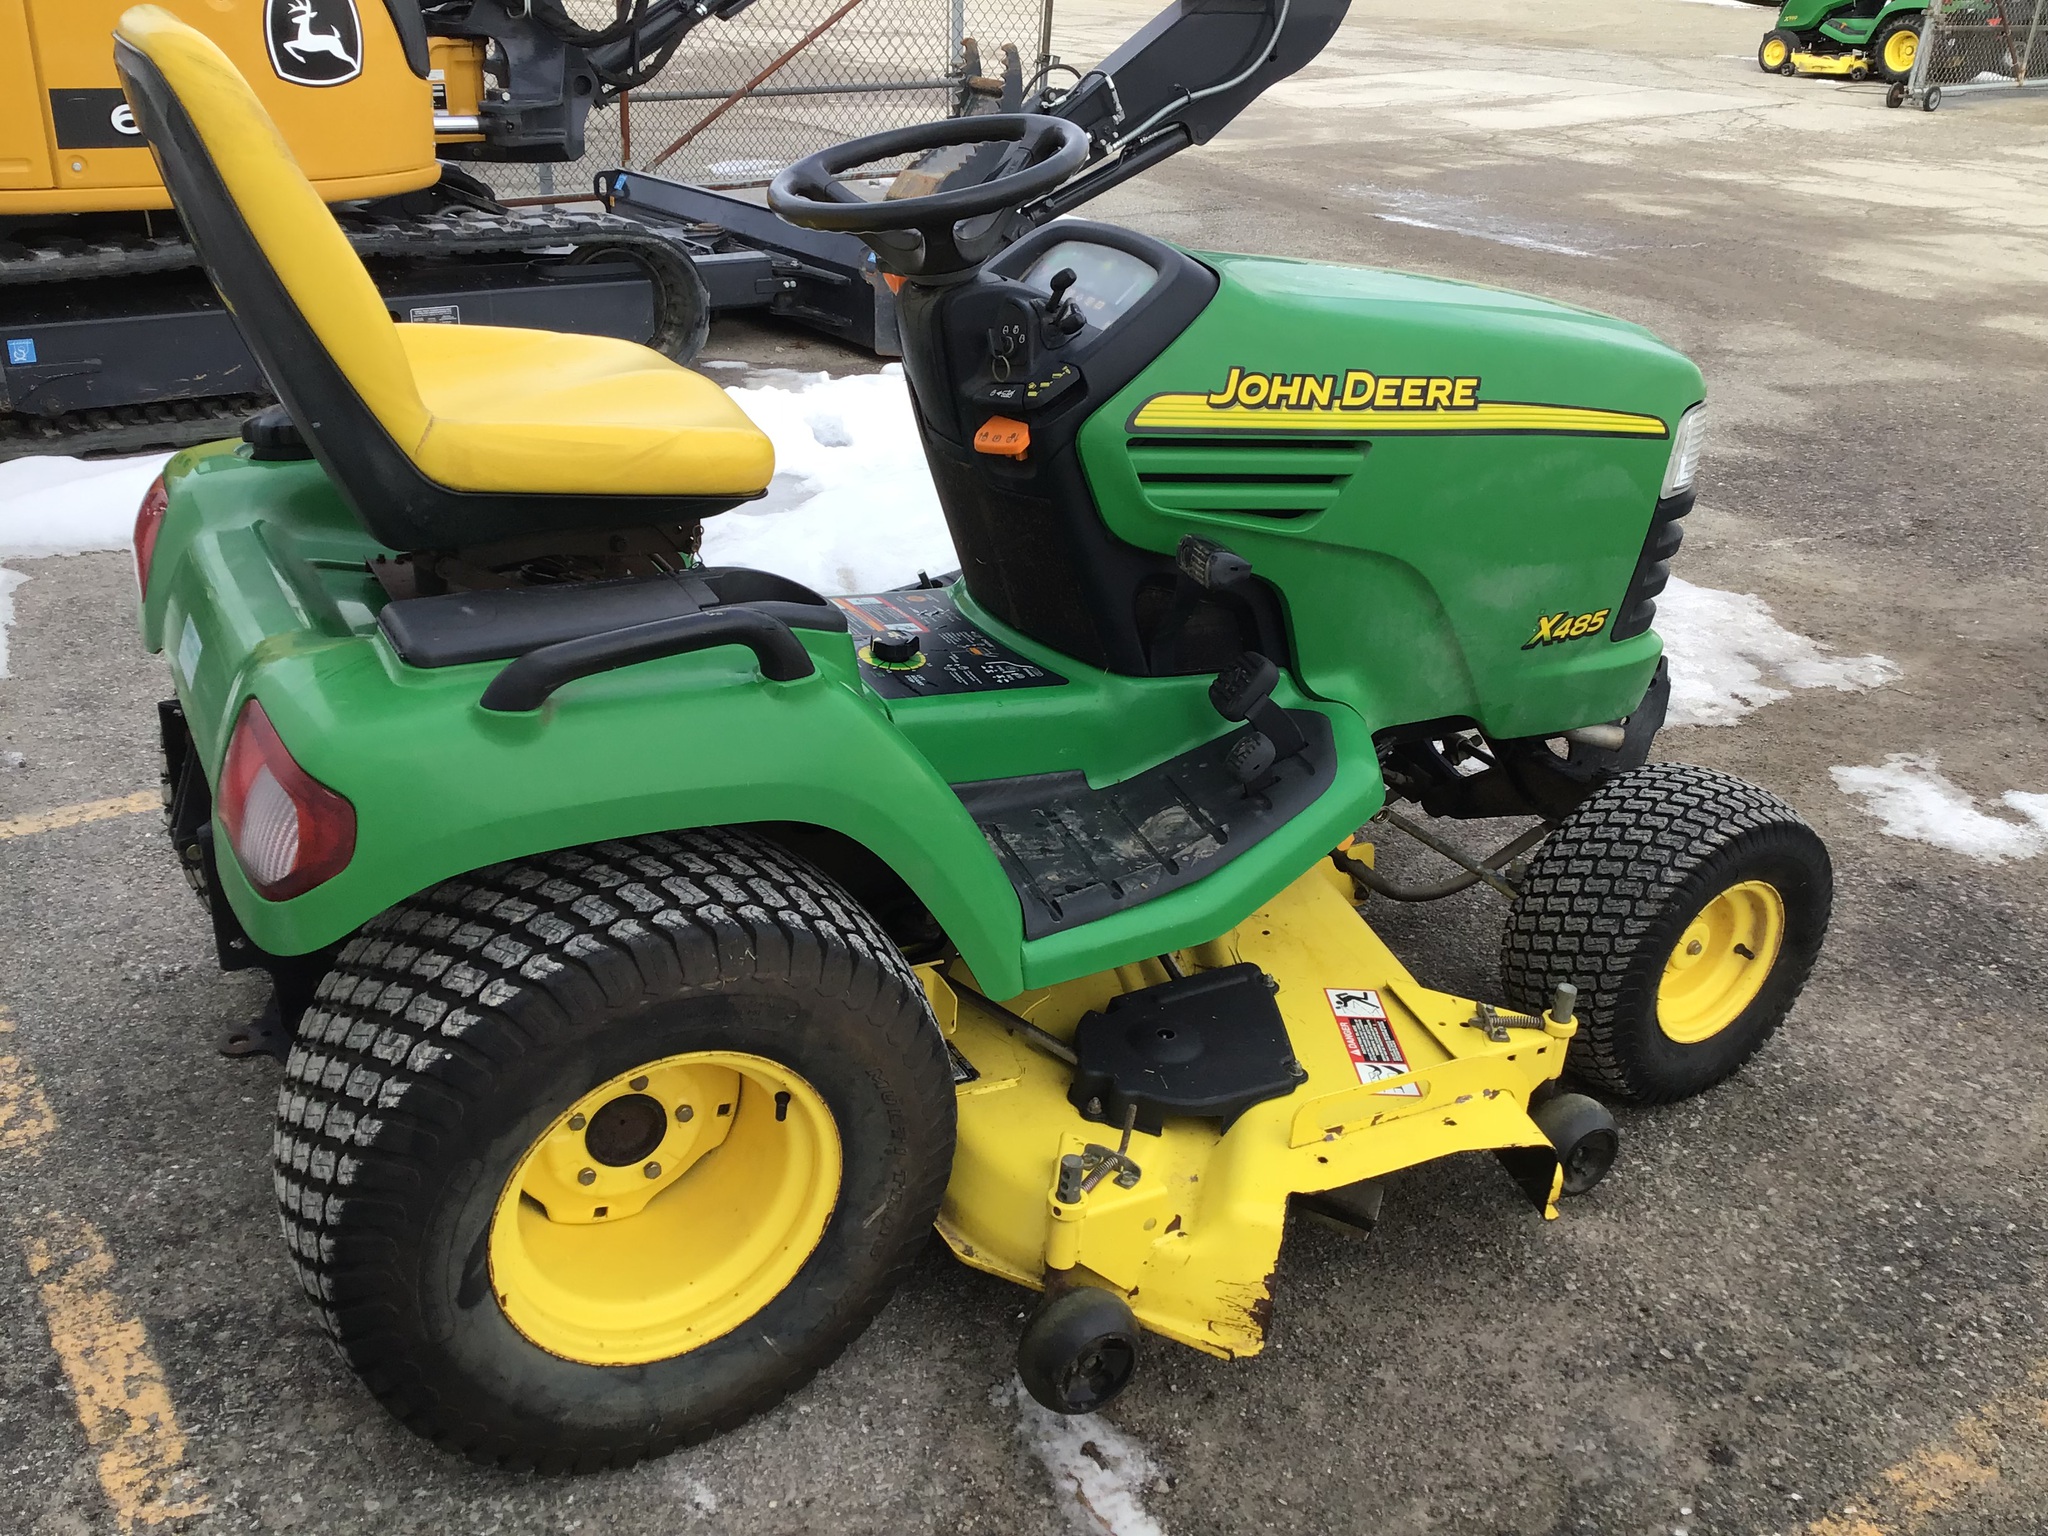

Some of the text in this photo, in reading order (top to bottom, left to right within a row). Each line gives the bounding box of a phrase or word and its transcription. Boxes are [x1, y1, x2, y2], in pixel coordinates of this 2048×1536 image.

[1208, 367, 1480, 412] JOHN DEERE
[1521, 608, 1612, 650] X485
[1340, 1021, 1358, 1049] DANGER
[865, 1067, 908, 1156] MULTI
